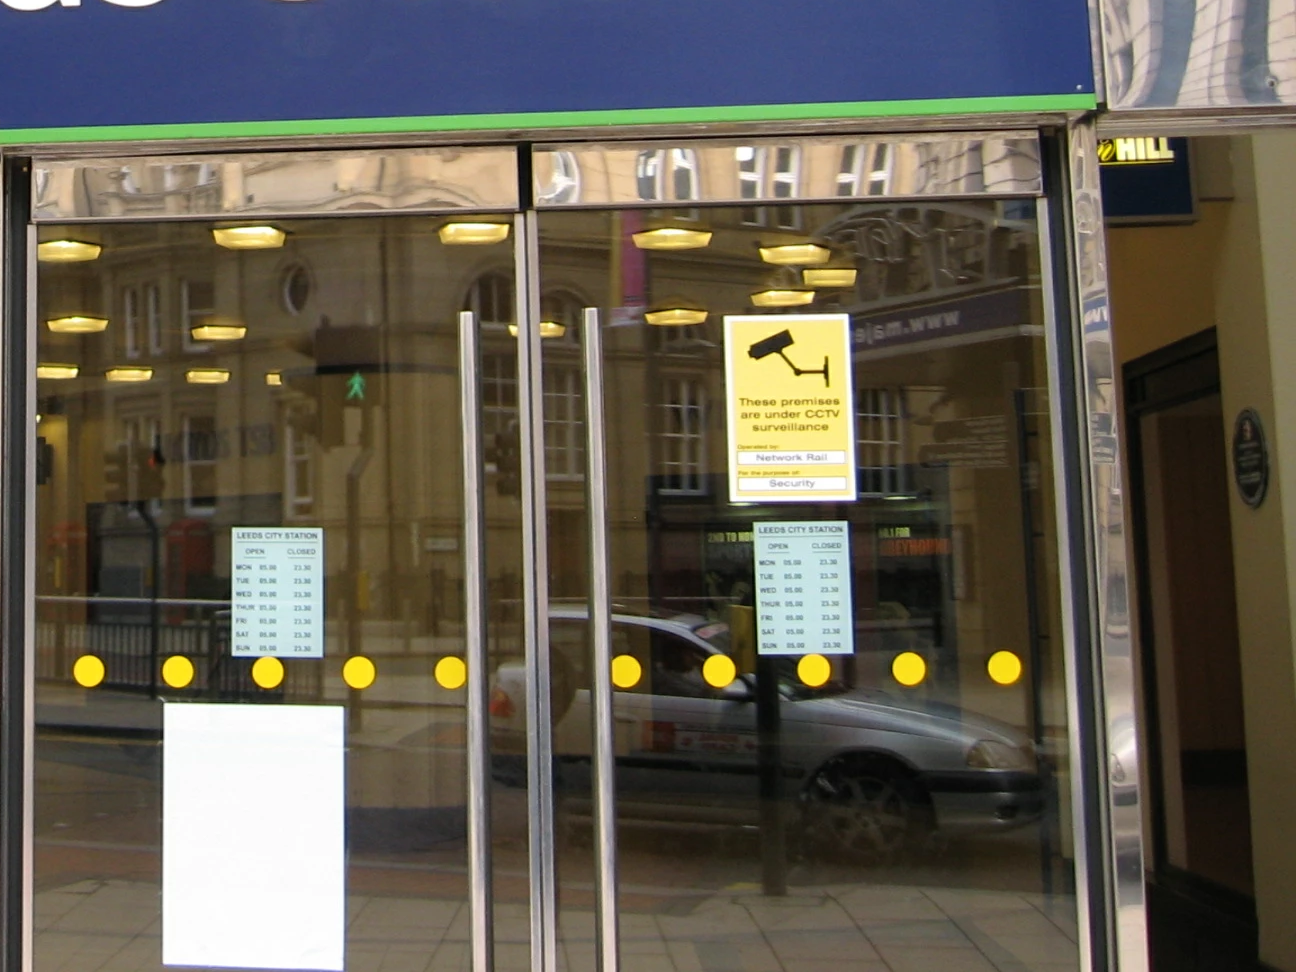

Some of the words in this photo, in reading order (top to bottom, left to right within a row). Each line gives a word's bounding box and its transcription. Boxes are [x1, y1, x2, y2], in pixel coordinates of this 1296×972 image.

[1116, 137, 1175, 161] HILL
[739, 398, 777, 407] These
[781, 397, 840, 408] premises
[740, 411, 760, 419] are
[764, 411, 801, 419] under
[805, 409, 840, 418] CCTV
[752, 422, 829, 432] surveillance
[806, 453, 828, 461] Rail
[769, 479, 815, 488] Security
